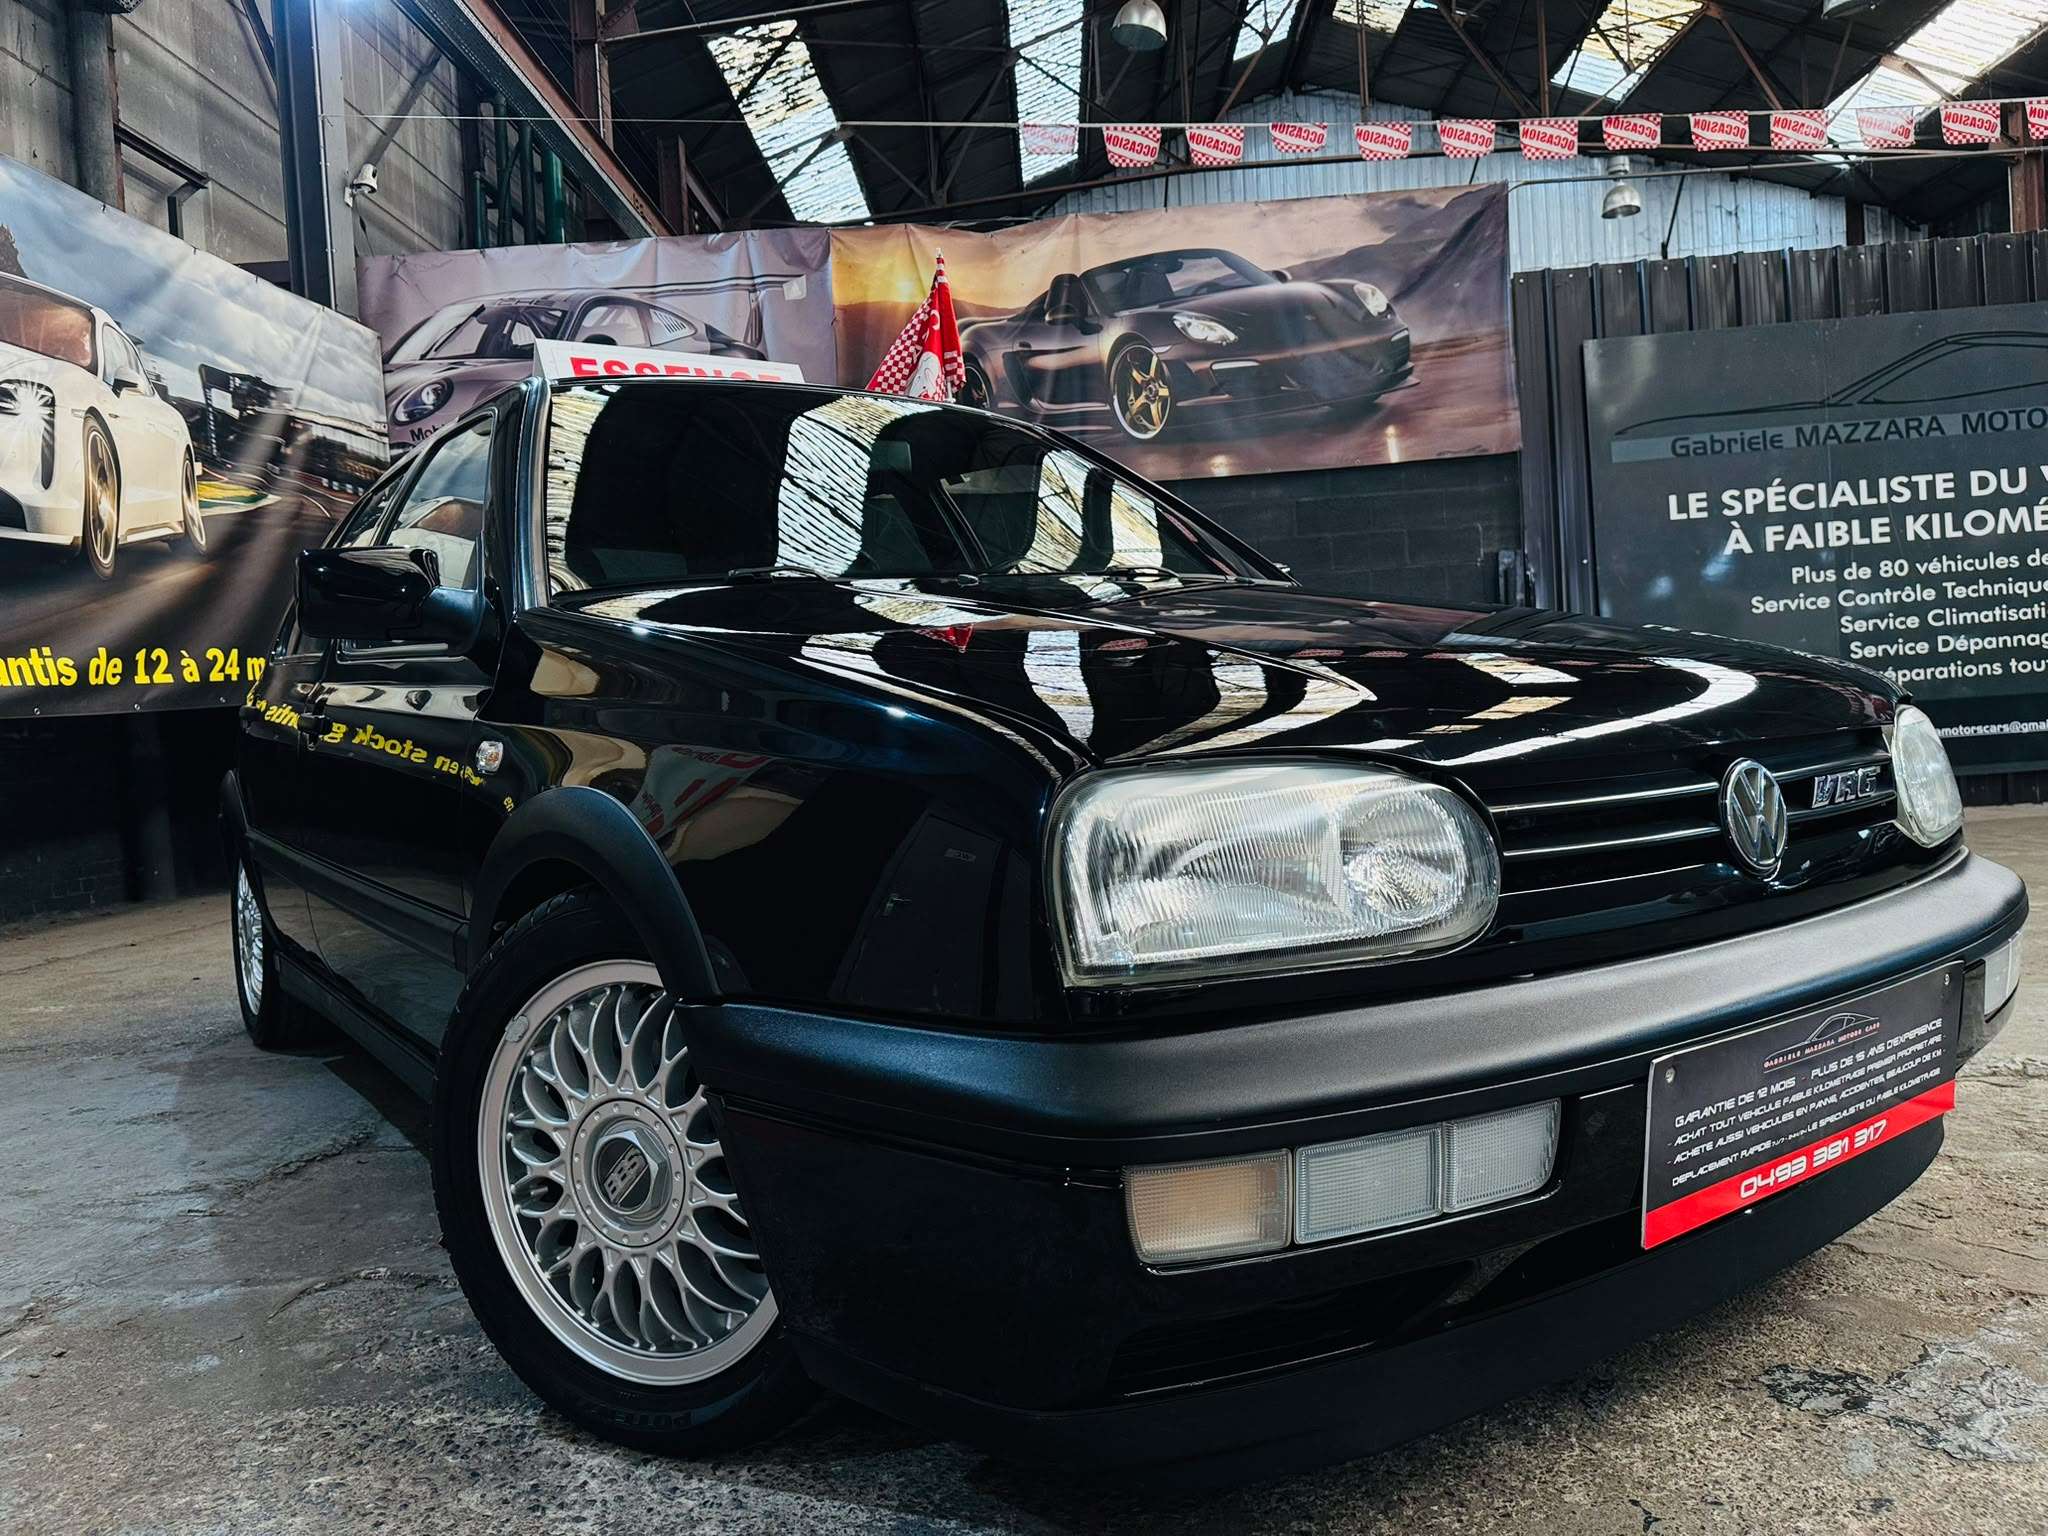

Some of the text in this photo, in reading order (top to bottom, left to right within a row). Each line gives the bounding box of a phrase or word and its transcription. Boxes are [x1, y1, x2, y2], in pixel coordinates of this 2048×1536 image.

[1671, 407, 2048, 458] Gabriele MAZZARA MOTO
[1668, 491, 1708, 521] LE
[1720, 478, 1955, 518] SPÉCIALISTE
[1969, 466, 2028, 497] DU
[1723, 521, 1753, 556] À
[1765, 517, 1892, 552] FAIBLE
[1791, 565, 1837, 584] Plus
[1843, 562, 1872, 581] de
[1879, 558, 1909, 578] 80
[1915, 551, 2020, 575] véhicules
[1751, 593, 1831, 614] Service
[1838, 583, 1936, 607] Contrôle
[1839, 612, 1920, 634] Service
[88, 647, 123, 686] de
[134, 647, 175, 685] 12
[180, 650, 201, 684] à
[205, 647, 240, 683] 24
[1849, 638, 1929, 660] Service
[2009, 657, 2048, 674] tou
[1674, 1126, 1707, 1147] ACHAT
[1709, 1116, 1736, 1133] TOUT
[1738, 1099, 1781, 1122] VEHICULE
[1866, 1053, 1897, 1073] PREMIER
[1675, 1097, 1736, 1128] GARANTIE
[1738, 1091, 1755, 1106] DE
[1757, 1087, 1768, 1099] 12
[1770, 1077, 1796, 1095] MOIS
[1810, 1061, 1839, 1080] PLUS
[1840, 1055, 1854, 1069] DE
[1855, 1050, 1866, 1063] 15
[1867, 1043, 1886, 1058] ANS
[1673, 1141, 1714, 1165] ACHETE
[1715, 1130, 1744, 1149] AUSSI
[1746, 1109, 1794, 1136] VEHICULES
[1796, 1105, 1809, 1117] EN
[1886, 1057, 1921, 1080] BEAUCOUP
[1921, 1052, 1931, 1063] DE
[1672, 1153, 1739, 1187] DEPLACEMENT
[1740, 1140, 1771, 1159] RAPIDE
[1740, 1155, 1807, 1199] 0493
[1812, 1136, 1849, 1168] 381
[1854, 1118, 1887, 1149] 317
